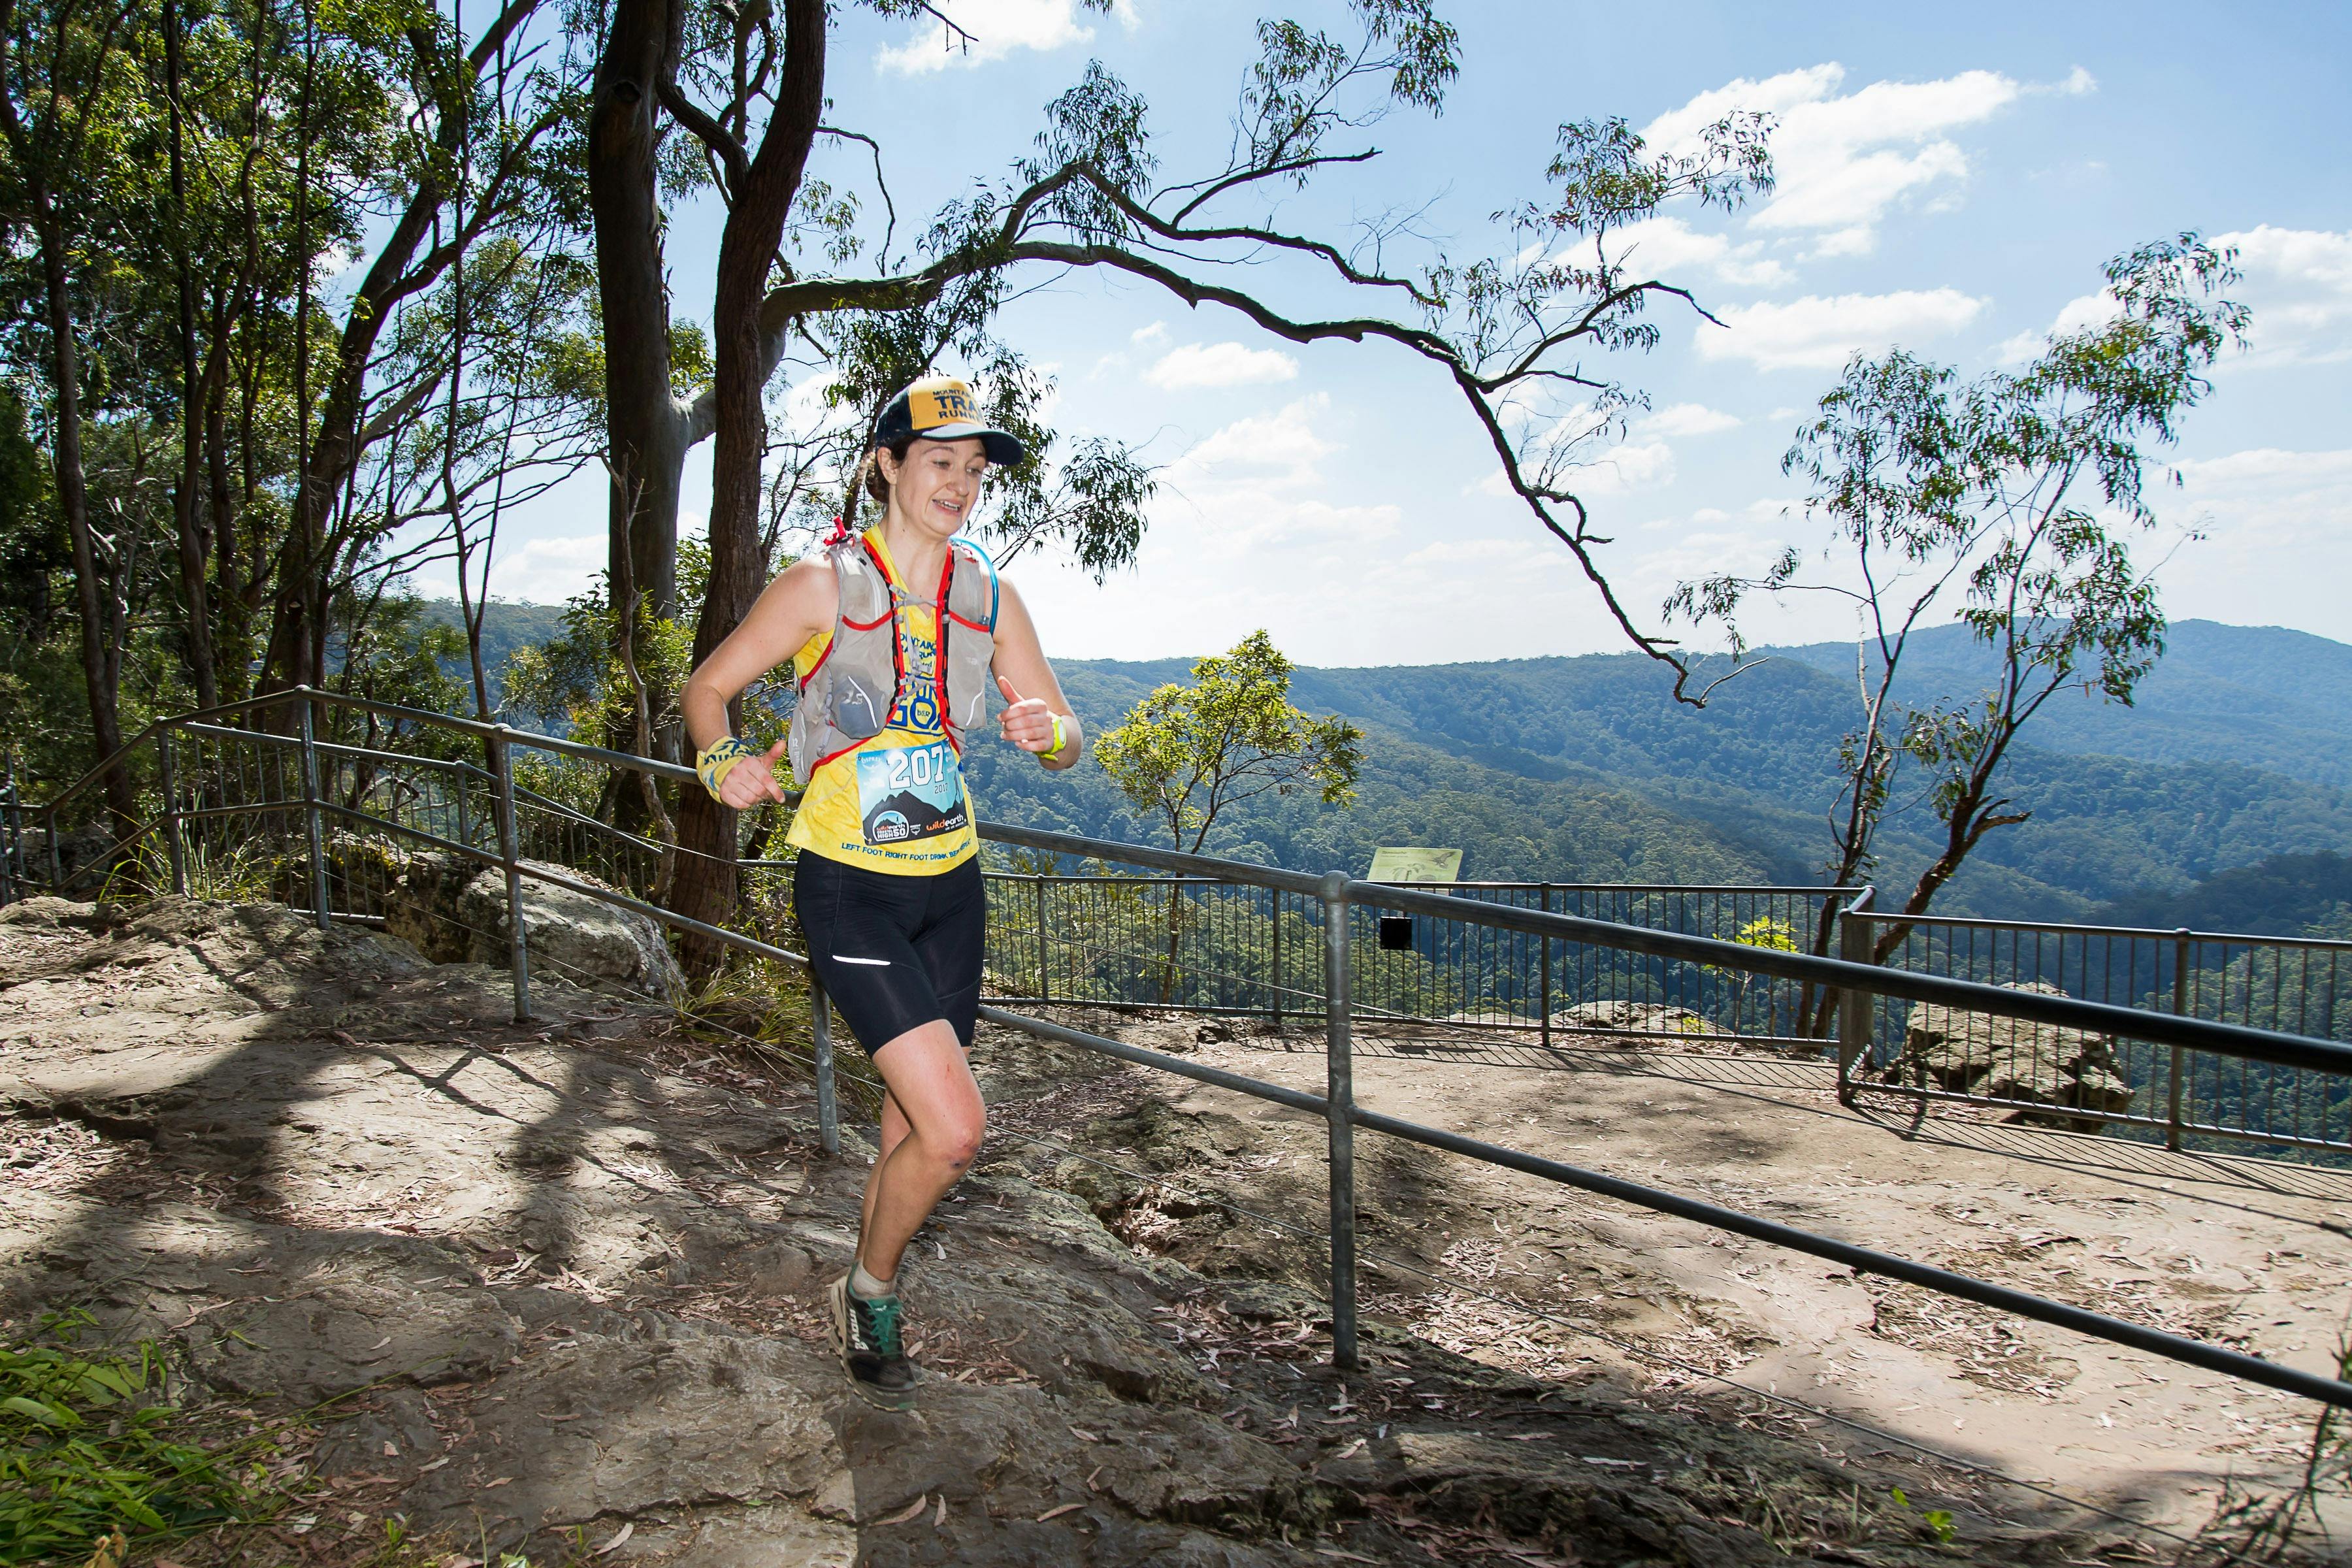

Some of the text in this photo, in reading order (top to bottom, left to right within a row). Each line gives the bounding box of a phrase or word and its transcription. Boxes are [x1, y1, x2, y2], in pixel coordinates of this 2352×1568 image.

[887, 745, 944, 789] 207
[934, 783, 948, 794] 2017
[926, 813, 964, 831] wildearth
[892, 828, 906, 837] 50
[841, 843, 860, 852] LEFT
[862, 847, 883, 856] FOOT
[885, 851, 908, 860] RIGHT
